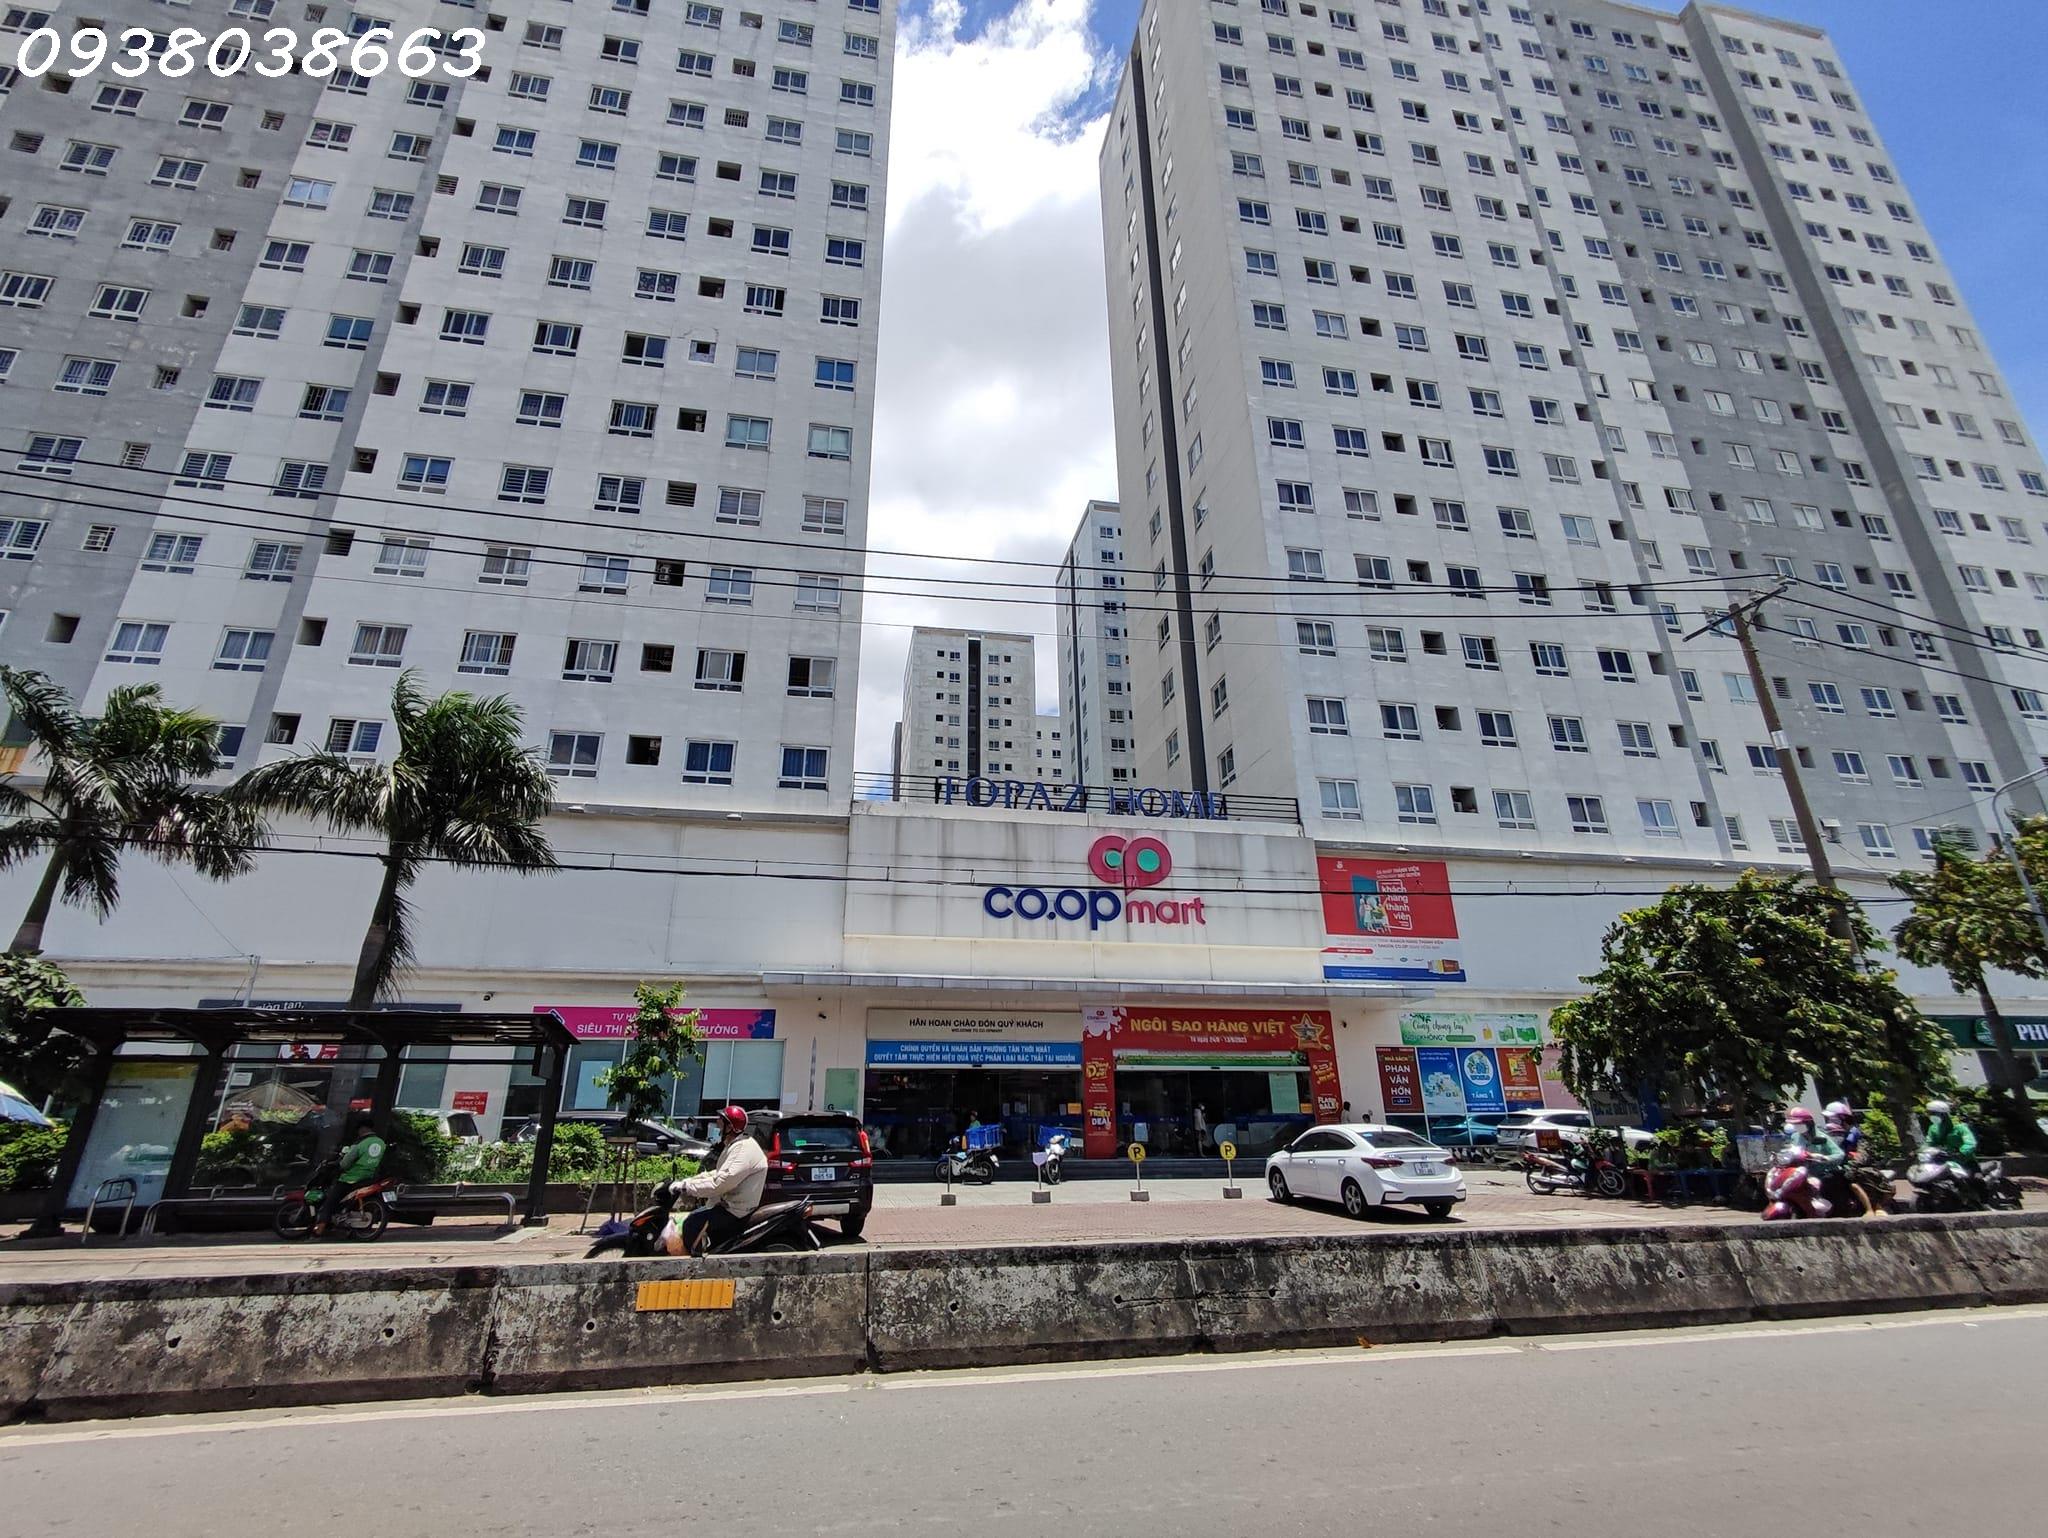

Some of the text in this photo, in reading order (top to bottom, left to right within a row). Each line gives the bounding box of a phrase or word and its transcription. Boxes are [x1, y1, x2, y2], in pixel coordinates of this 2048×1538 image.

[939, 775, 1229, 821] TOPAZ HOME
[1382, 885, 1407, 893] khách
[576, 1021, 603, 1034] SIÊU
[604, 1023, 623, 1035] THỊ
[929, 1019, 952, 1027] HOAN
[953, 1018, 977, 1028] CHÀO
[1016, 1019, 1044, 1029] KHÁCH
[1130, 1017, 1285, 1037] NGÔI SAO HÀNG VIỆT
[1385, 1064, 1411, 1073] PHAN
[1389, 1075, 1409, 1084] VĂN
[1091, 1116, 1111, 1126] DEAL
